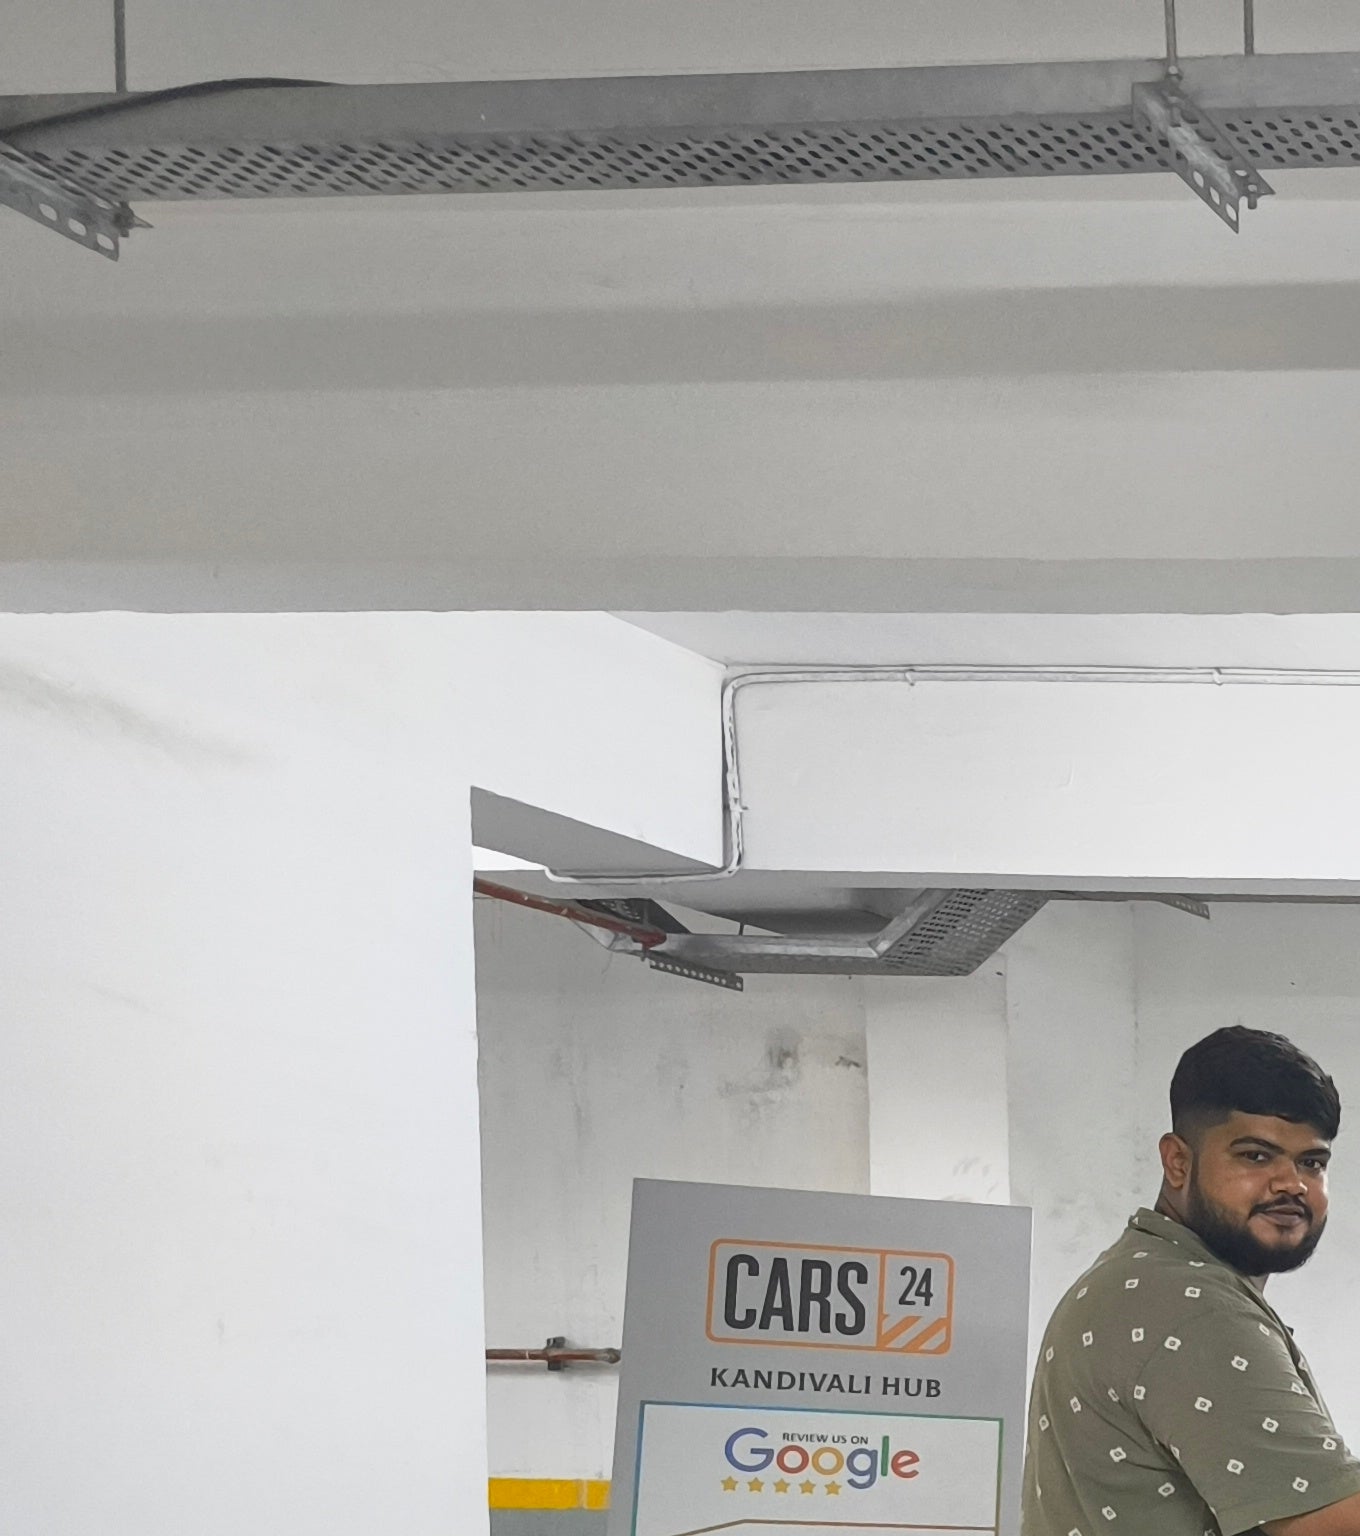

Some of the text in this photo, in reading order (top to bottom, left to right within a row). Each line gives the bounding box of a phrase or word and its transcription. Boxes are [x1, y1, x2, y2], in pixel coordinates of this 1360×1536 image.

[724, 1253, 934, 1336] CARS 24
[710, 1367, 942, 1398] KANDIVALI HUB
[724, 1427, 920, 1490] Google
[782, 1432, 869, 1445] REVIEW US ON
